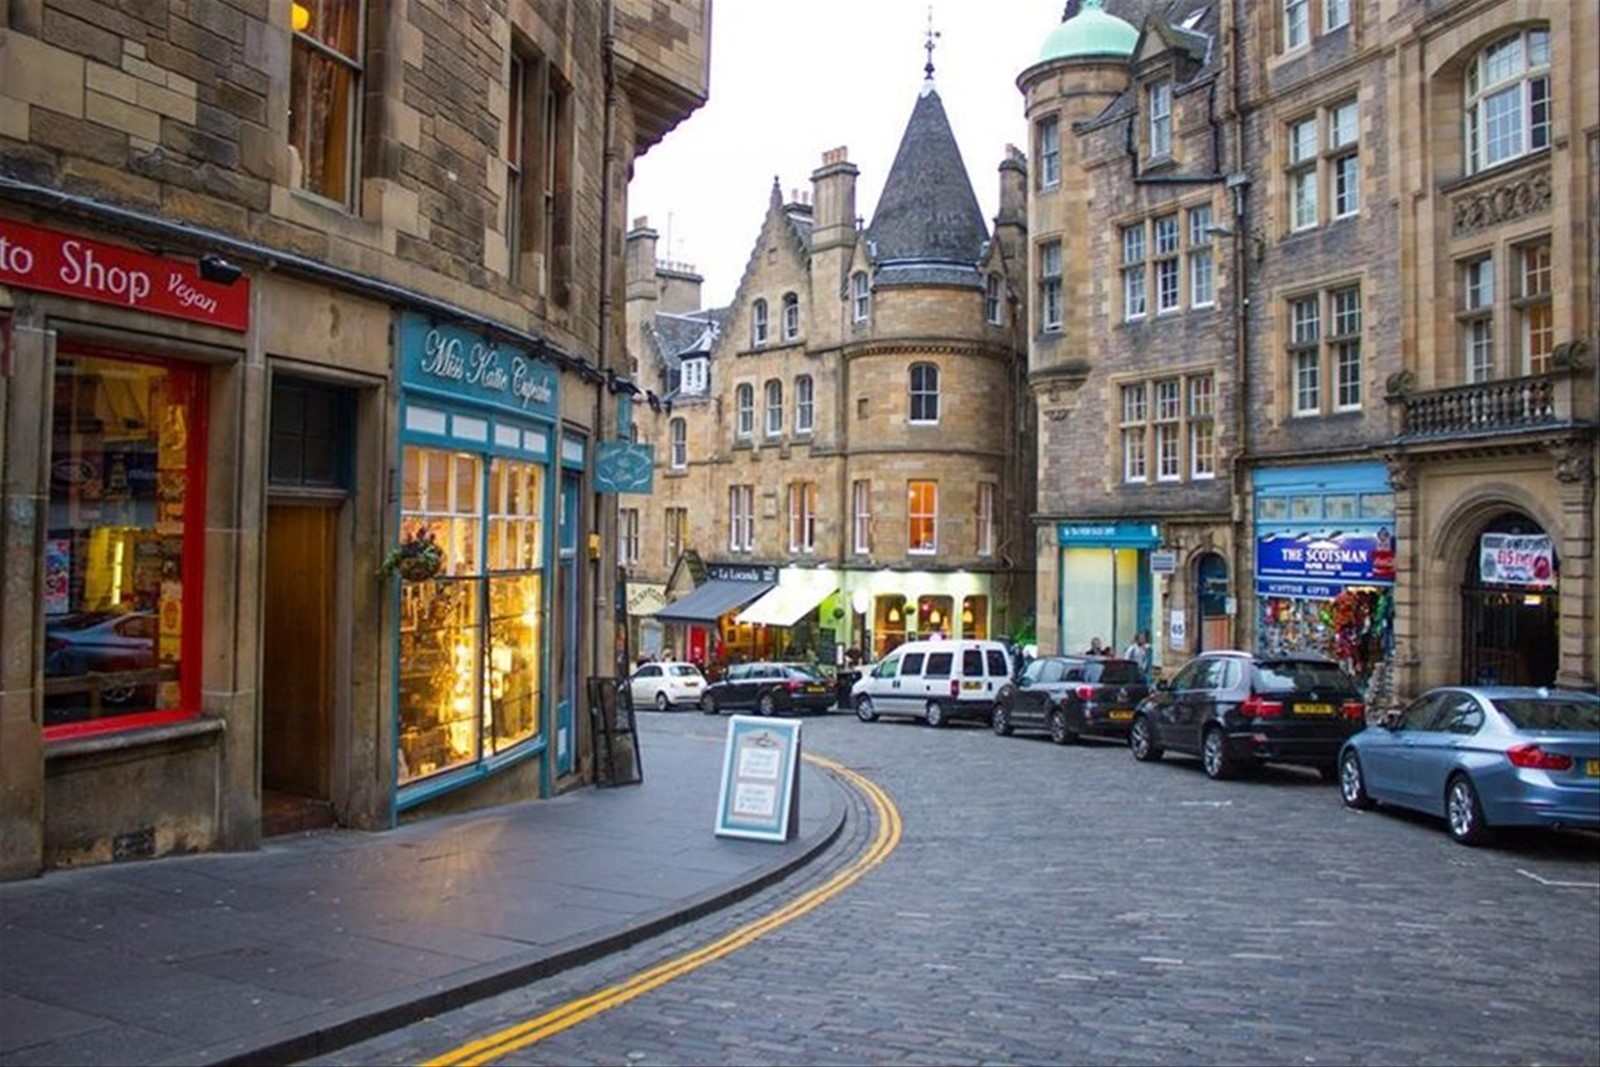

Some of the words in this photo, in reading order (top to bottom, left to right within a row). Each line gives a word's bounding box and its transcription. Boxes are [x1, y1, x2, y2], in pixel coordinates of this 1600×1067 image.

[60, 240, 150, 303] Shop
[166, 273, 217, 313] Vegan
[421, 329, 464, 380] Miss
[466, 343, 508, 391] Katie
[1281, 548, 1303, 562] THE
[1305, 548, 1368, 563] SCOTSMAN
[1306, 585, 1330, 595] GIFTS
